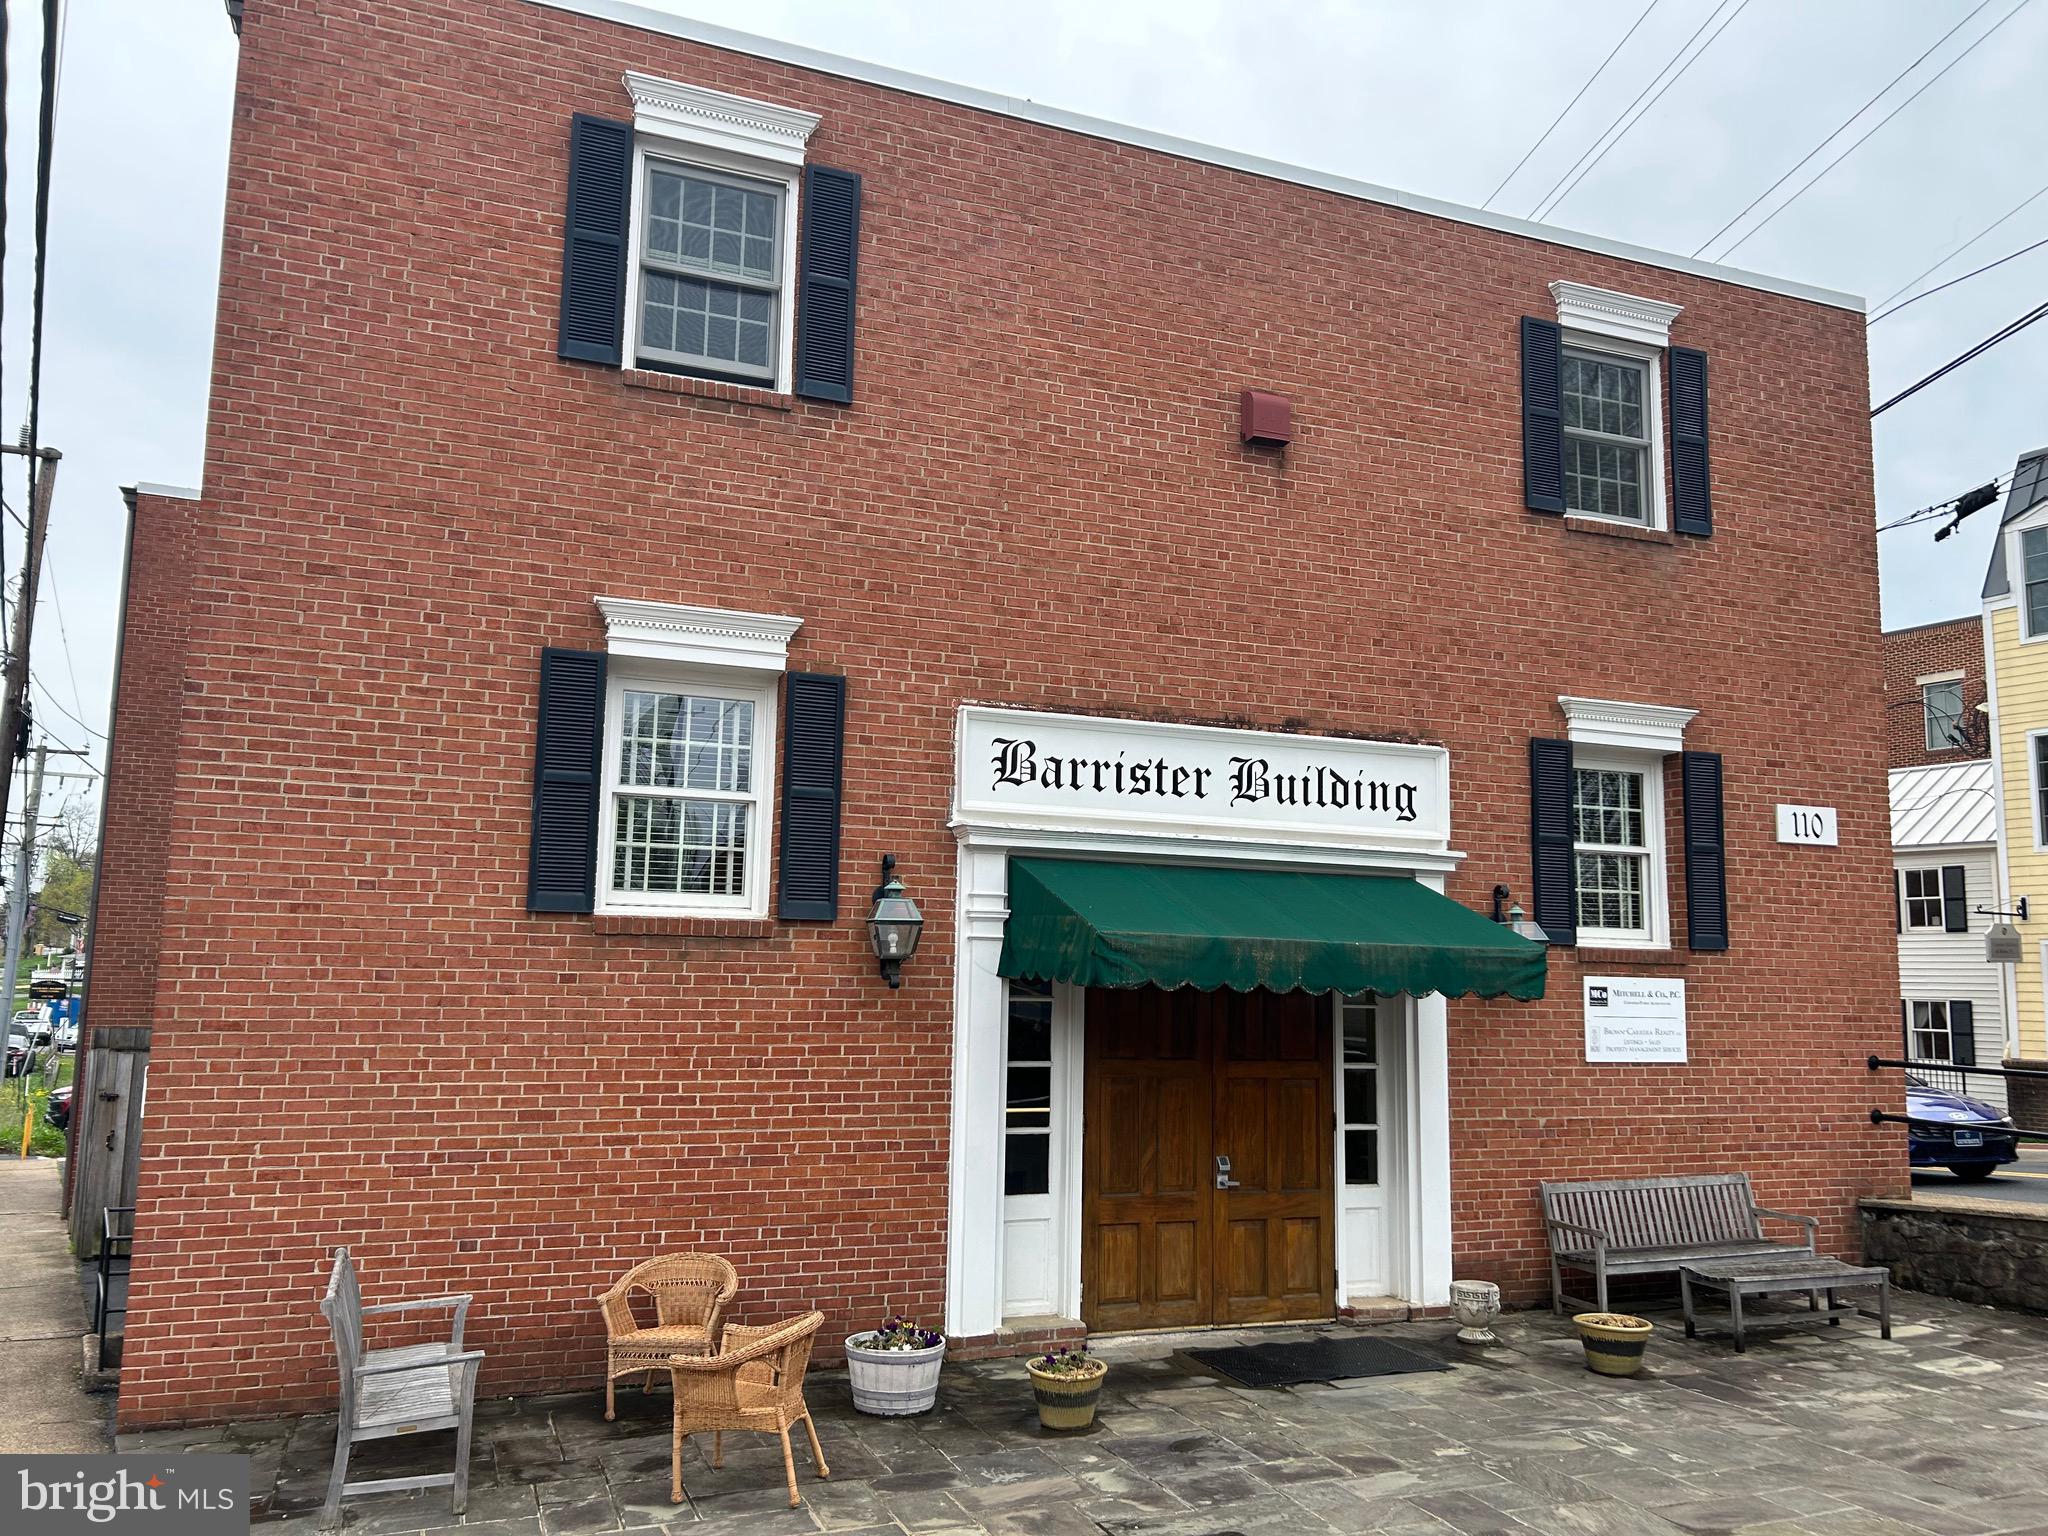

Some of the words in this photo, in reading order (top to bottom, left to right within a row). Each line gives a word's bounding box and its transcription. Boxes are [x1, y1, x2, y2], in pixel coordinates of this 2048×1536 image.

[991, 737, 1212, 799] Barrister
[1228, 756, 1418, 822] Building
[1792, 812, 1823, 838] 110
